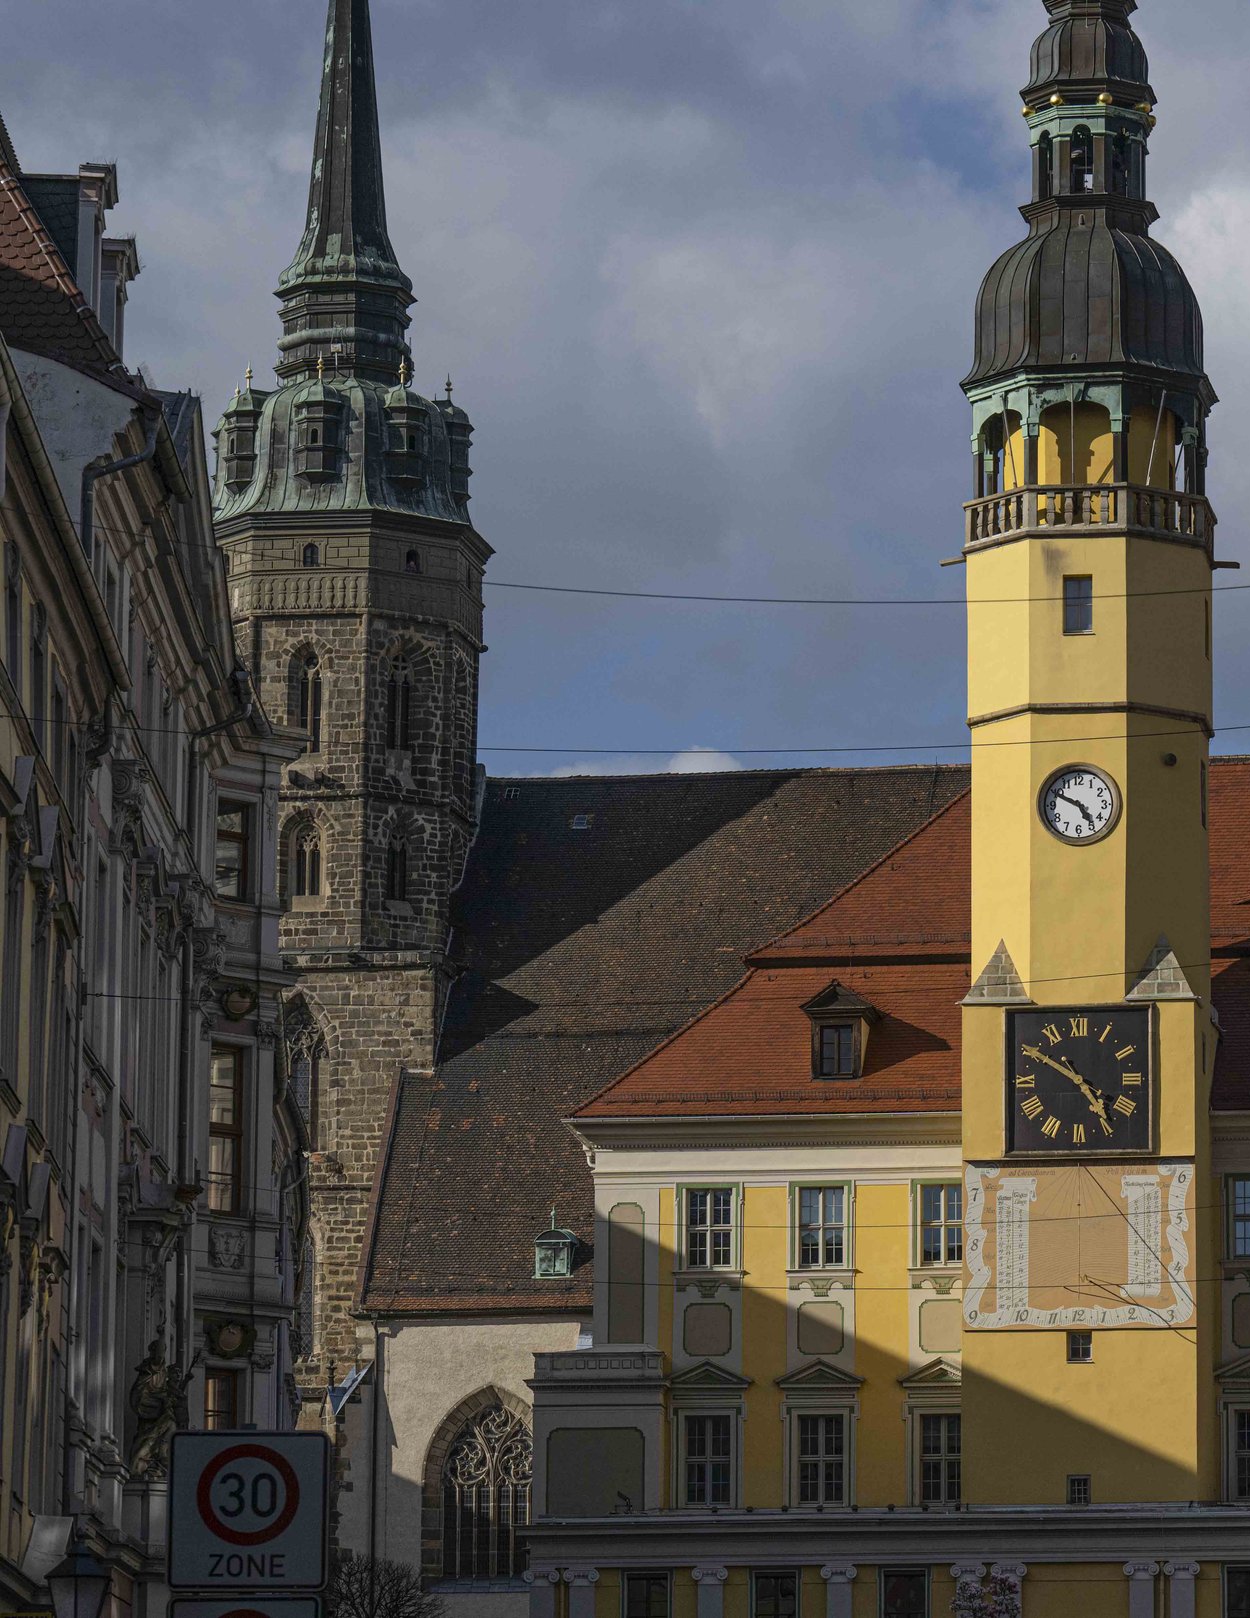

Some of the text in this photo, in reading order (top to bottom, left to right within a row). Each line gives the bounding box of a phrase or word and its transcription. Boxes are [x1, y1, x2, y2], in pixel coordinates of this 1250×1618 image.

[1070, 1017, 1088, 1037] XII
[1042, 1024, 1062, 1046] XI
[1122, 1072, 1142, 1086] III
[1177, 1170, 1187, 1184] 6
[970, 1187, 980, 1203] 7
[1175, 1212, 1184, 1226] 5
[970, 1238, 980, 1252] 8
[1173, 1261, 1183, 1276] 4
[968, 1309, 979, 1325] 9
[1014, 1309, 1030, 1323] 10
[1048, 1312, 1059, 1326] 11
[1071, 1310, 1086, 1323] 12
[1128, 1308, 1138, 1322] 2
[1166, 1310, 1176, 1323] 3
[218, 1472, 278, 1518] 30
[208, 1554, 286, 1578] ZONE
